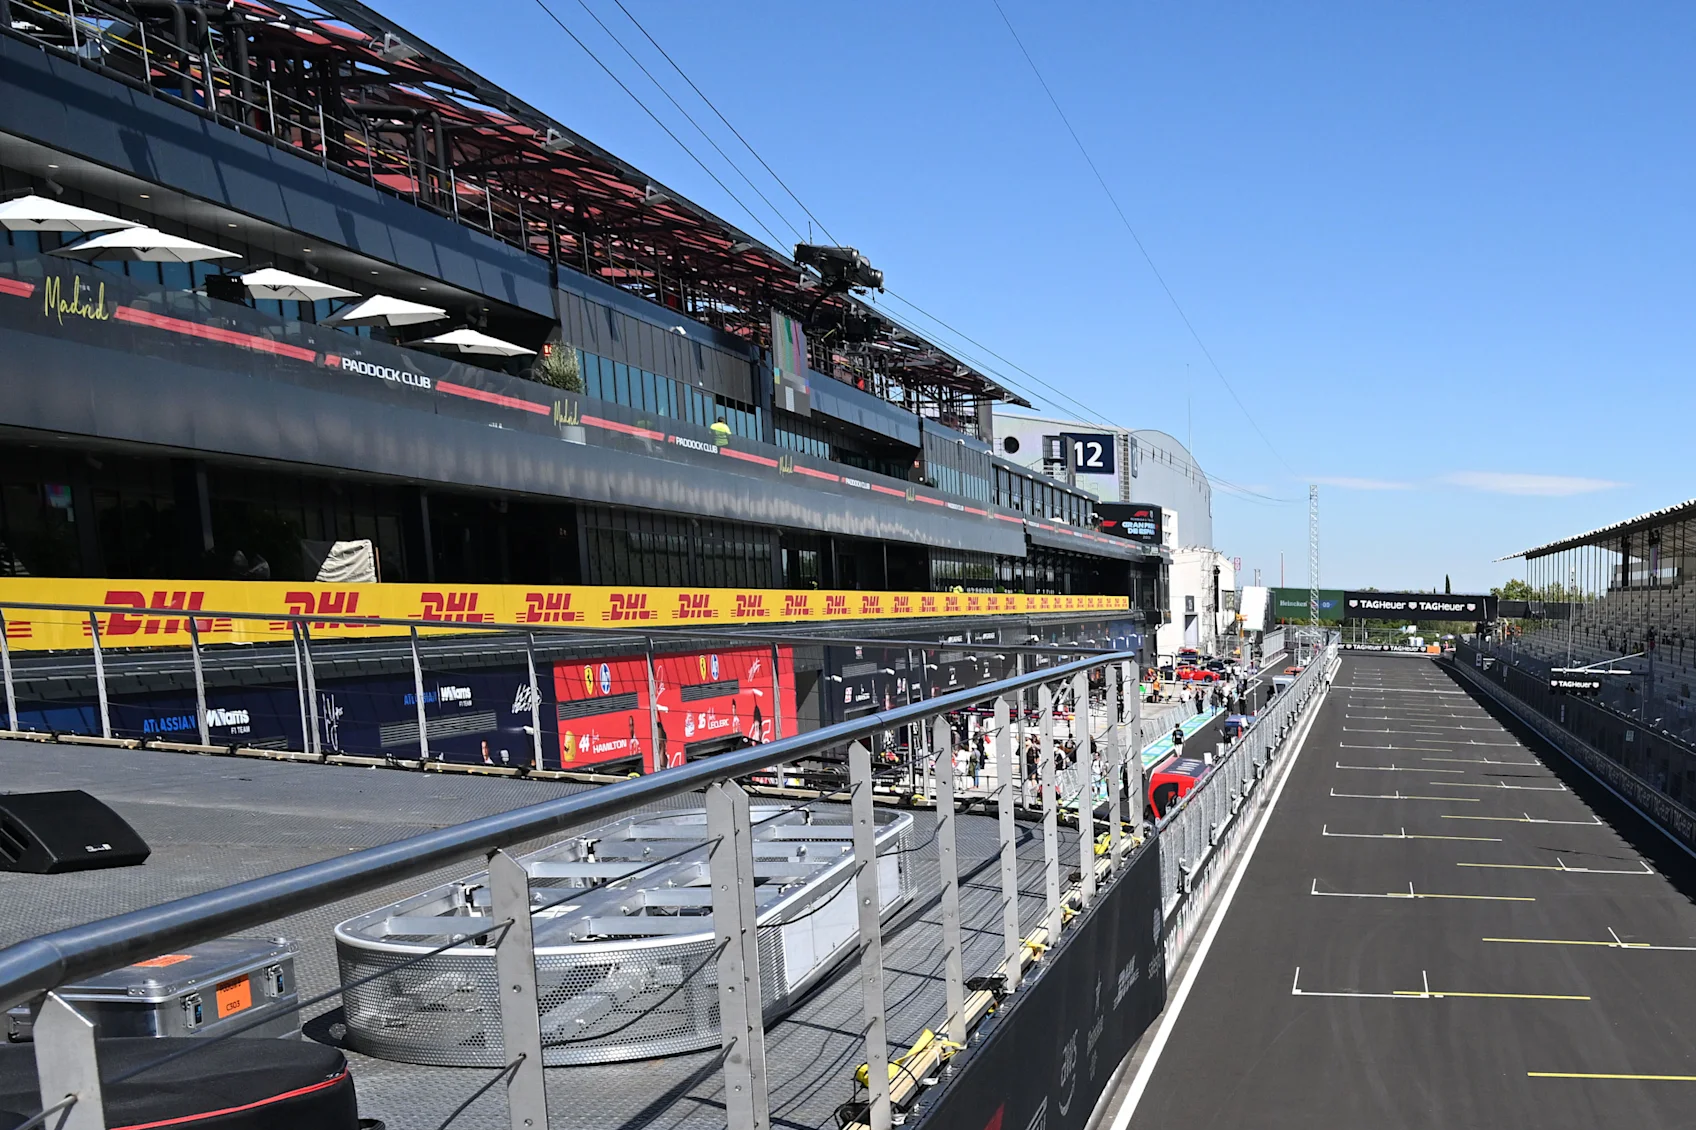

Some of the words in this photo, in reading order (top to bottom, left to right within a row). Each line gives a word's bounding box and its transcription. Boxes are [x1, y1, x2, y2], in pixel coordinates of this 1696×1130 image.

[44, 275, 109, 326] Madrid
[342, 358, 400, 382] PADDOCK
[402, 371, 431, 389] CLUB
[676, 436, 704, 451] PADDOCK
[704, 442, 718, 454] CLUB
[1074, 441, 1103, 467] 12
[104, 591, 214, 635] DHL
[420, 592, 484, 623] DHL
[525, 593, 576, 622] DHL
[609, 594, 650, 621] DHL
[678, 594, 712, 618] DHL
[735, 595, 765, 617] DHL
[784, 595, 809, 615] DHL
[826, 595, 847, 614] DHL
[861, 596, 881, 614] DHL
[1360, 600, 1406, 610] TAGHeuer
[1419, 602, 1465, 611] TAGHeuer
[1558, 680, 1592, 688] TAGHeuer
[143, 715, 195, 734] ATLASSIAN
[206, 708, 250, 729] Williams
[237, 725, 250, 733] TEAM
[708, 717, 730, 730] LECLERC
[579, 734, 590, 753] 44
[592, 738, 627, 754] HAMILTON
